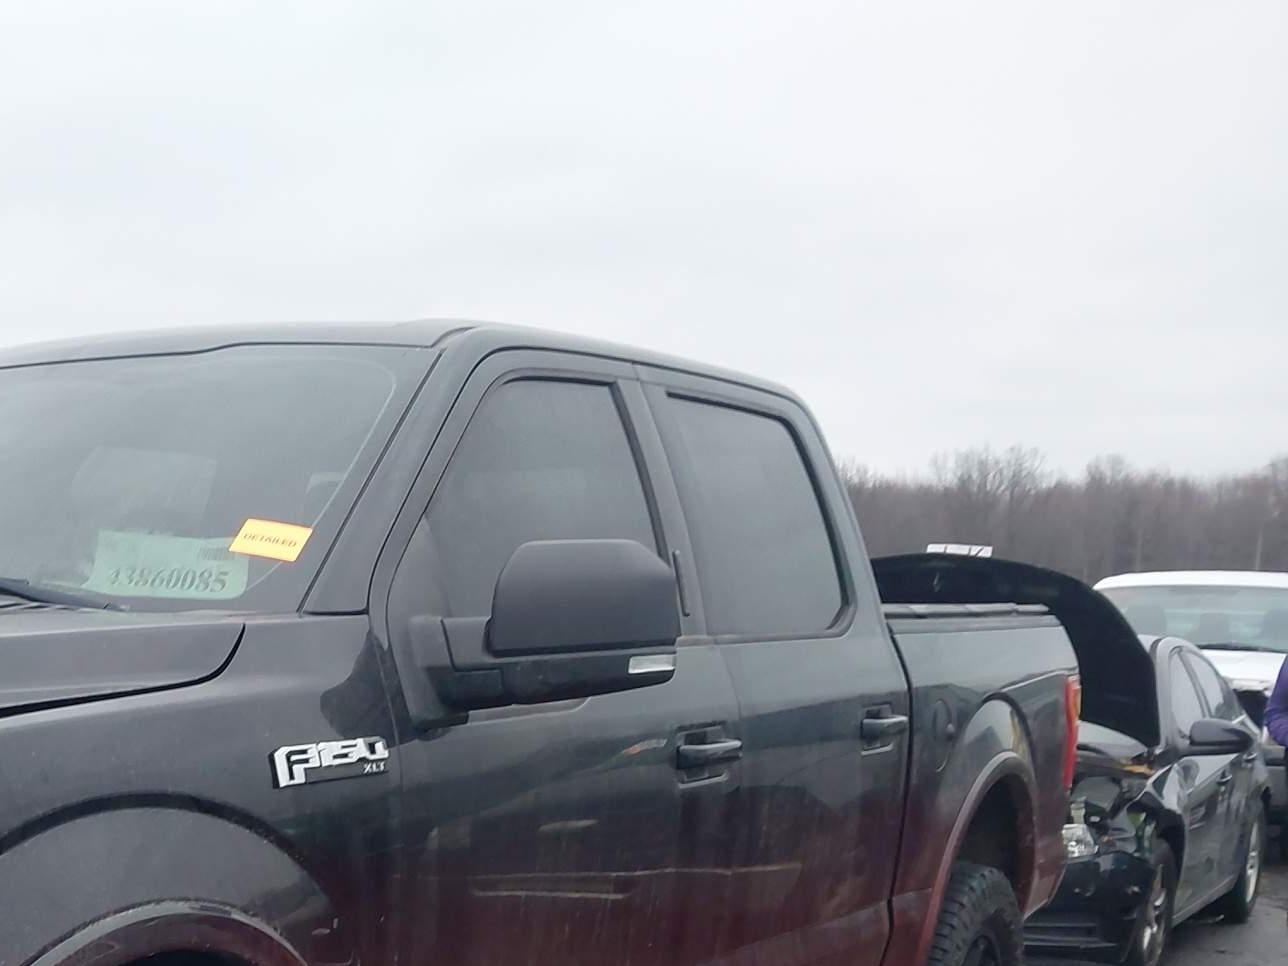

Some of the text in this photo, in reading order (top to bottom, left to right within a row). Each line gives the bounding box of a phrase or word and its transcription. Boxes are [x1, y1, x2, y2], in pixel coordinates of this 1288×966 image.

[243, 532, 298, 548] DETAILED
[110, 566, 230, 593] 43860085
[363, 761, 386, 774] XLT
